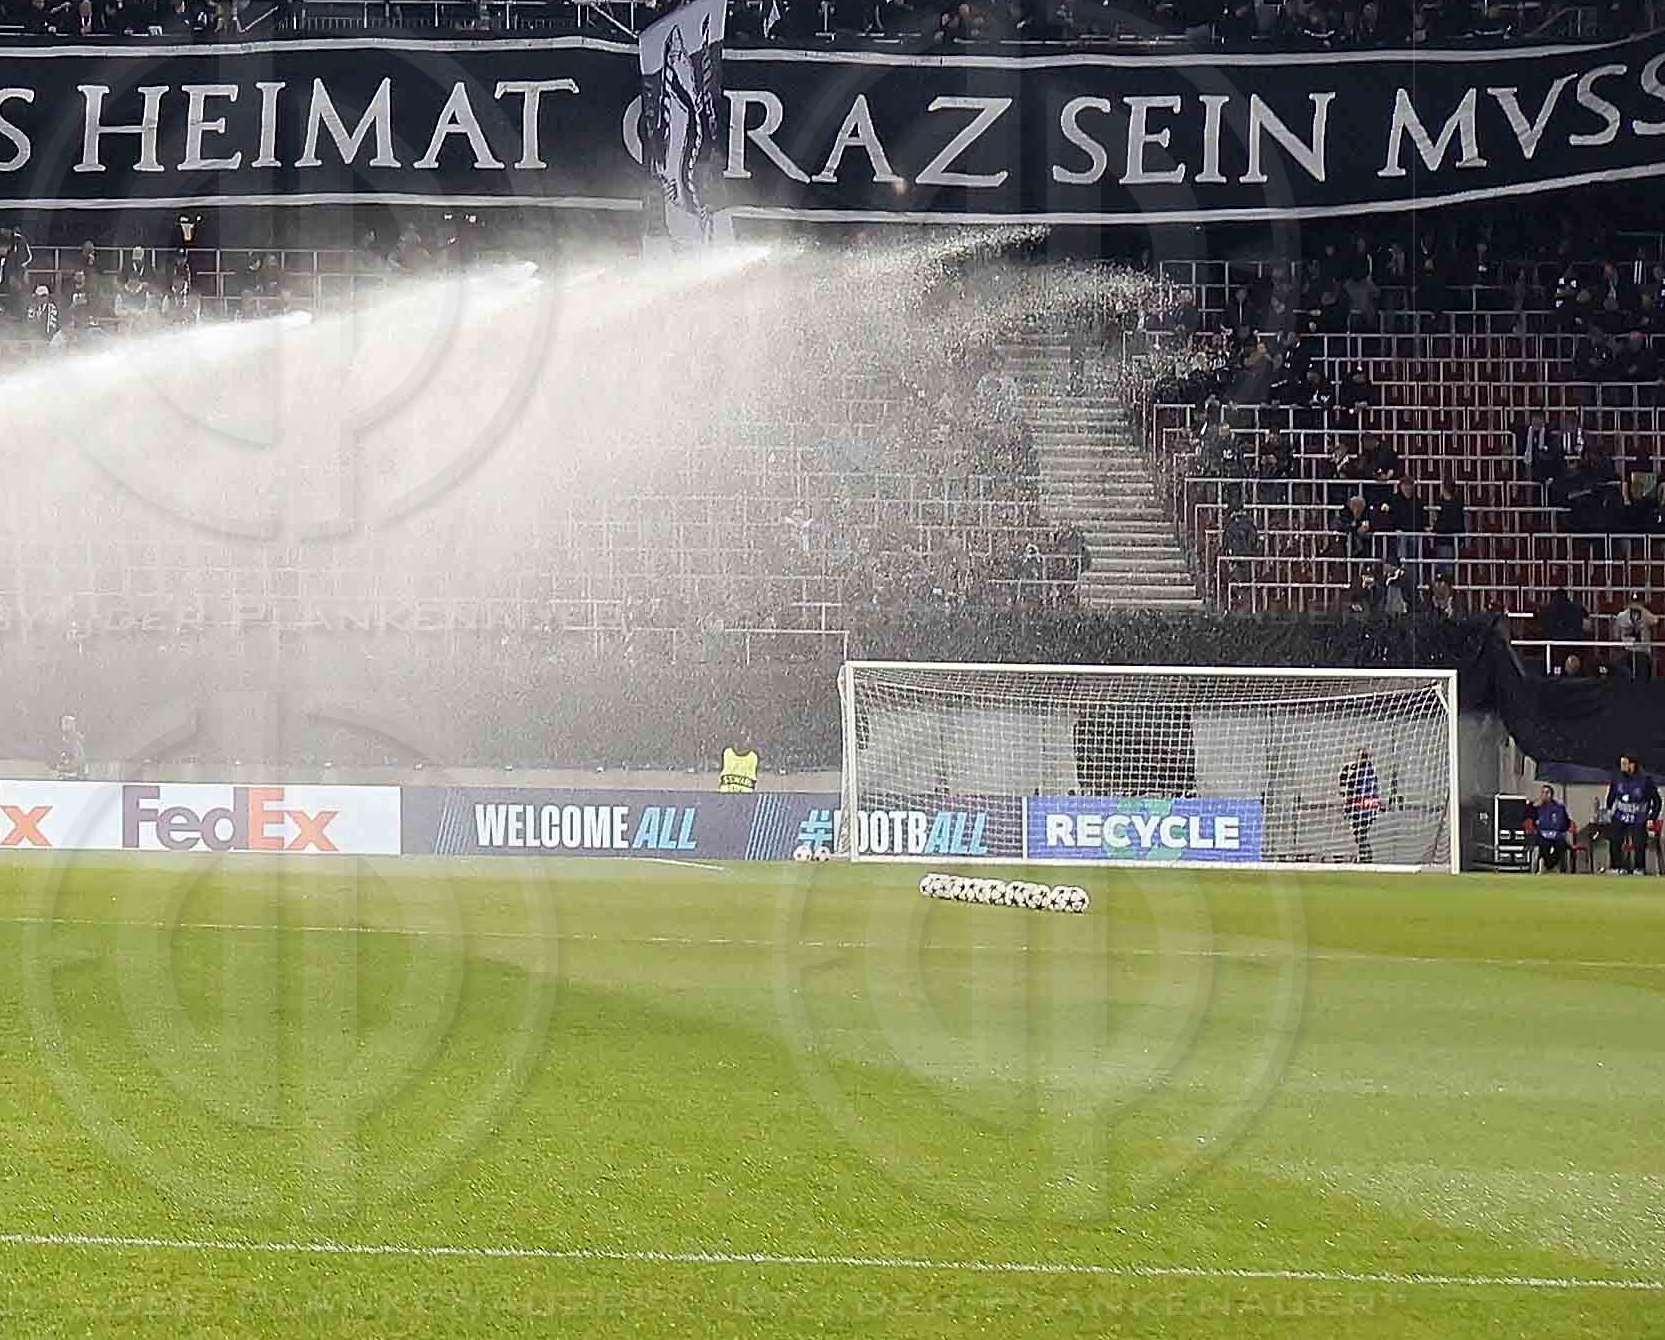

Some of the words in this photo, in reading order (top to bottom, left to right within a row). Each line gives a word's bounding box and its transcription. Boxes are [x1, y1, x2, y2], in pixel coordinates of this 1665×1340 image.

[71, 76, 580, 172] HEIMAT
[1052, 92, 1336, 186] SEIN
[122, 784, 339, 851] FedEx
[475, 803, 629, 848] WELCOME
[631, 806, 698, 850] ALL
[1046, 814, 1240, 849] RECYCLE
